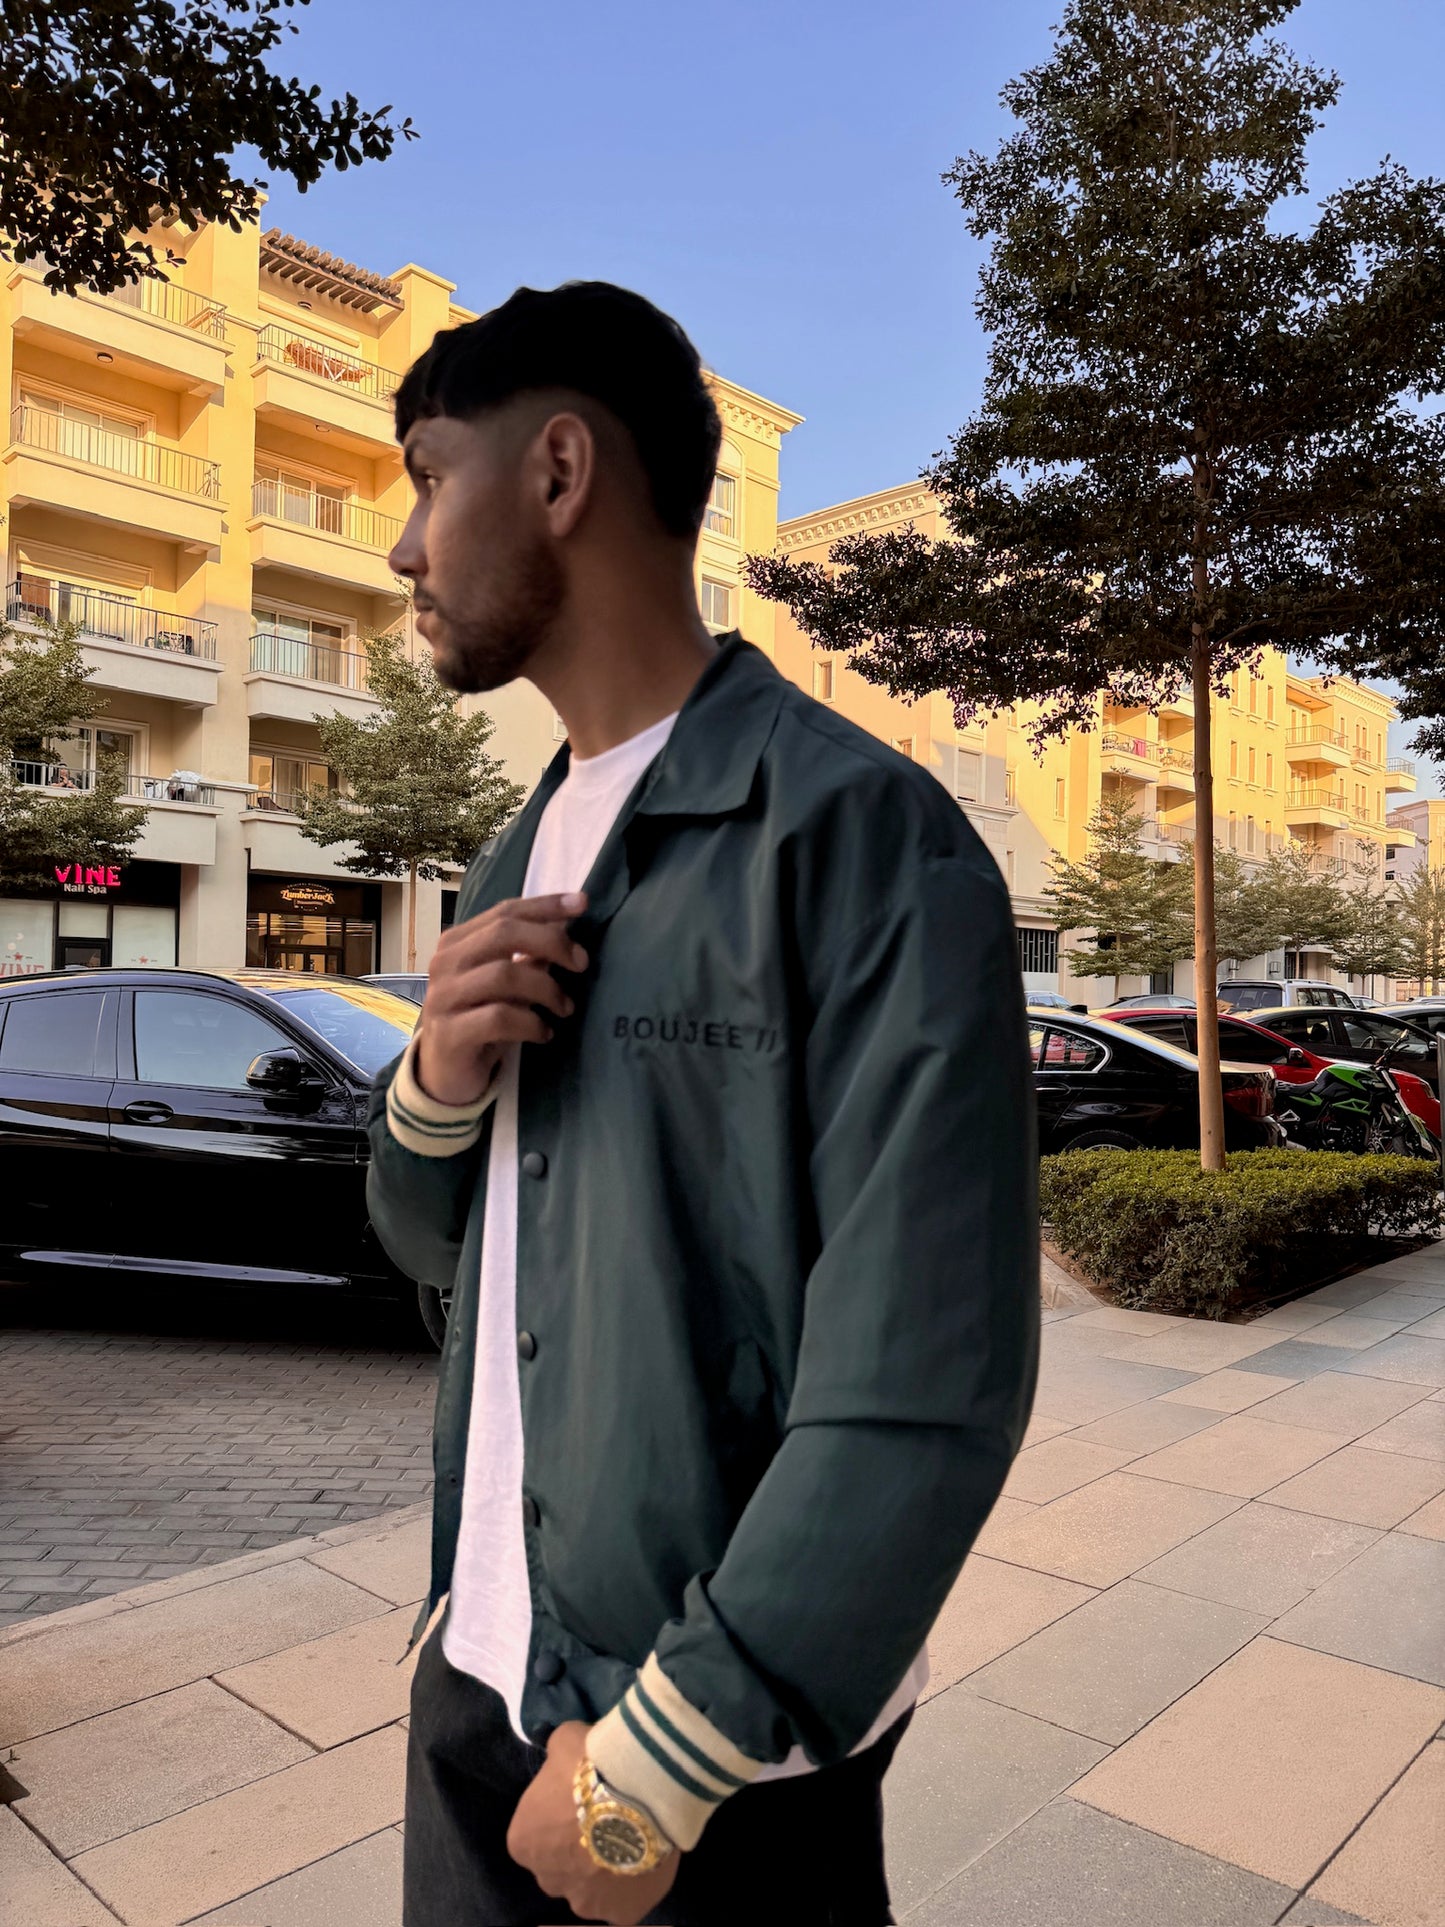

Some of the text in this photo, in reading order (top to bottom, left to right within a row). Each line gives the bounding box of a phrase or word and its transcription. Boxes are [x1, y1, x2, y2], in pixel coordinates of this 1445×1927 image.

[55, 863, 121, 886] VINE
[64, 883, 107, 895] Nail Spa
